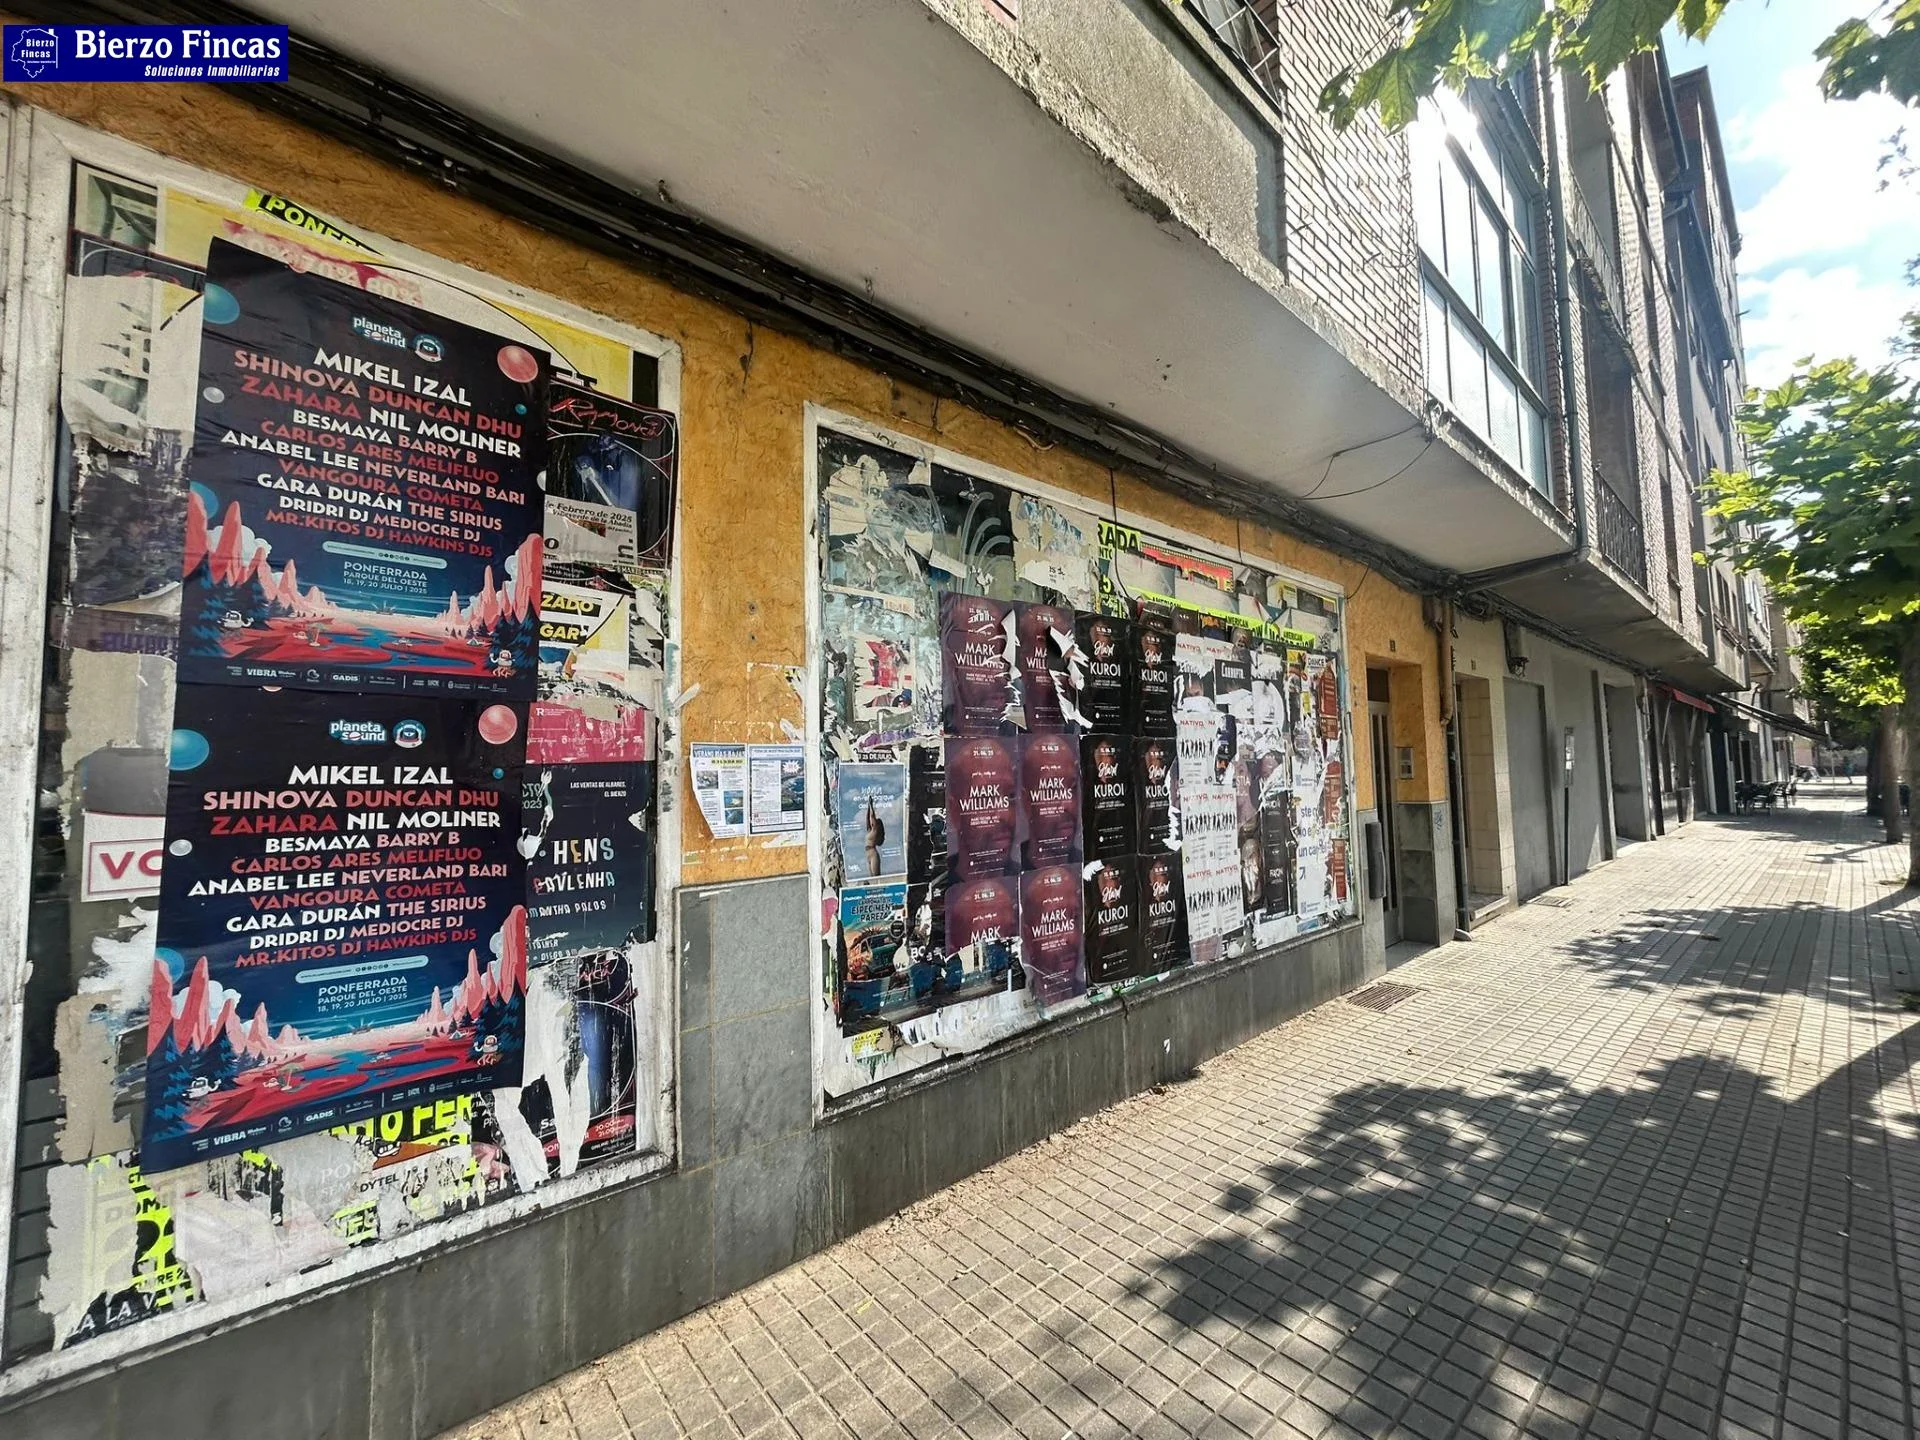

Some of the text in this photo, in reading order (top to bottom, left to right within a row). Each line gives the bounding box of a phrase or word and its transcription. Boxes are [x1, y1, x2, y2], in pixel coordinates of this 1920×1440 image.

[353, 316, 402, 338] planeta
[364, 327, 407, 348] sound
[313, 347, 472, 407] MIKEL IZAL
[234, 349, 522, 438] SHINOVA DUNCAN DHU
[240, 375, 521, 458] ZAHARA NIL MOLINER
[293, 409, 477, 464] BESMAYA BARRY B
[260, 420, 500, 484] CARLOS ARES MELIFLUO
[221, 430, 526, 506] ANABEL LEE NEVERLAND BARI
[279, 459, 485, 512] VANGOURA COMETA
[257, 473, 503, 531] GARA DURÁN THE SIRIUS
[279, 495, 482, 543] DRIDRI DJ MEDIOCRE DJ
[557, 502, 595, 517] Febrero
[598, 511, 609, 519] de
[610, 512, 632, 523] 2025
[364, 526, 385, 540] DJ
[388, 530, 466, 553] HAWKINS
[469, 543, 494, 557] DJS
[343, 561, 428, 581] PONFERRADA
[343, 570, 428, 588] PARQUE DEL OESTE
[368, 581, 379, 589] 20
[379, 582, 403, 592] JULIO
[541, 594, 594, 613] ZADO
[965, 642, 996, 656] MARK
[955, 652, 1005, 670] WILLIAMS
[1090, 662, 1121, 677] KUROI
[247, 668, 278, 678] VIBRA
[332, 674, 359, 682] GADIS
[1141, 669, 1168, 683] KUROI
[330, 719, 381, 733] planeta
[341, 729, 386, 741] sound
[288, 765, 454, 785] MIKEL IZAL
[1038, 777, 1065, 789] MARK
[203, 790, 499, 810] SHINOVA DUNCAN DHU
[969, 784, 1000, 798] MARK
[1030, 788, 1073, 802] WILLIAMS
[1094, 783, 1125, 798] KUROI
[1145, 785, 1170, 798] KURO
[522, 800, 543, 809] 023
[960, 796, 1010, 811] WILLIAMS
[210, 811, 501, 835] ZAHARA NIL MOLINER
[265, 831, 460, 853] BESMAYA BARRY B
[553, 837, 615, 865] HENS
[231, 847, 483, 874] CARLOS ARES MELIFLUO
[187, 864, 507, 897] ANABEL LEE NEVERLAND BARI
[251, 881, 466, 911] VANGOURA COMETA
[226, 896, 487, 932] GARA DURÁN THE SIRIUS
[525, 903, 571, 919] MANTHA
[1041, 908, 1067, 924] MARK
[1098, 905, 1129, 925] KUROI
[1149, 899, 1176, 917] KUROI
[250, 915, 464, 949] DRIDRI DJ MEDIOCRE DJ
[970, 925, 1002, 944] MARK
[1031, 919, 1075, 938] WILLIAMS
[341, 941, 362, 954] DJ
[366, 931, 447, 952] HAWKINS
[451, 928, 477, 942] DJS
[317, 985, 408, 1005] PARQUE DEL OESTE
[318, 976, 408, 997] PONFERRADA
[356, 997, 382, 1007] JULIO
[388, 992, 408, 1002] 2025
[305, 1110, 335, 1122] GADIS
[213, 1130, 247, 1146] VIBRA
